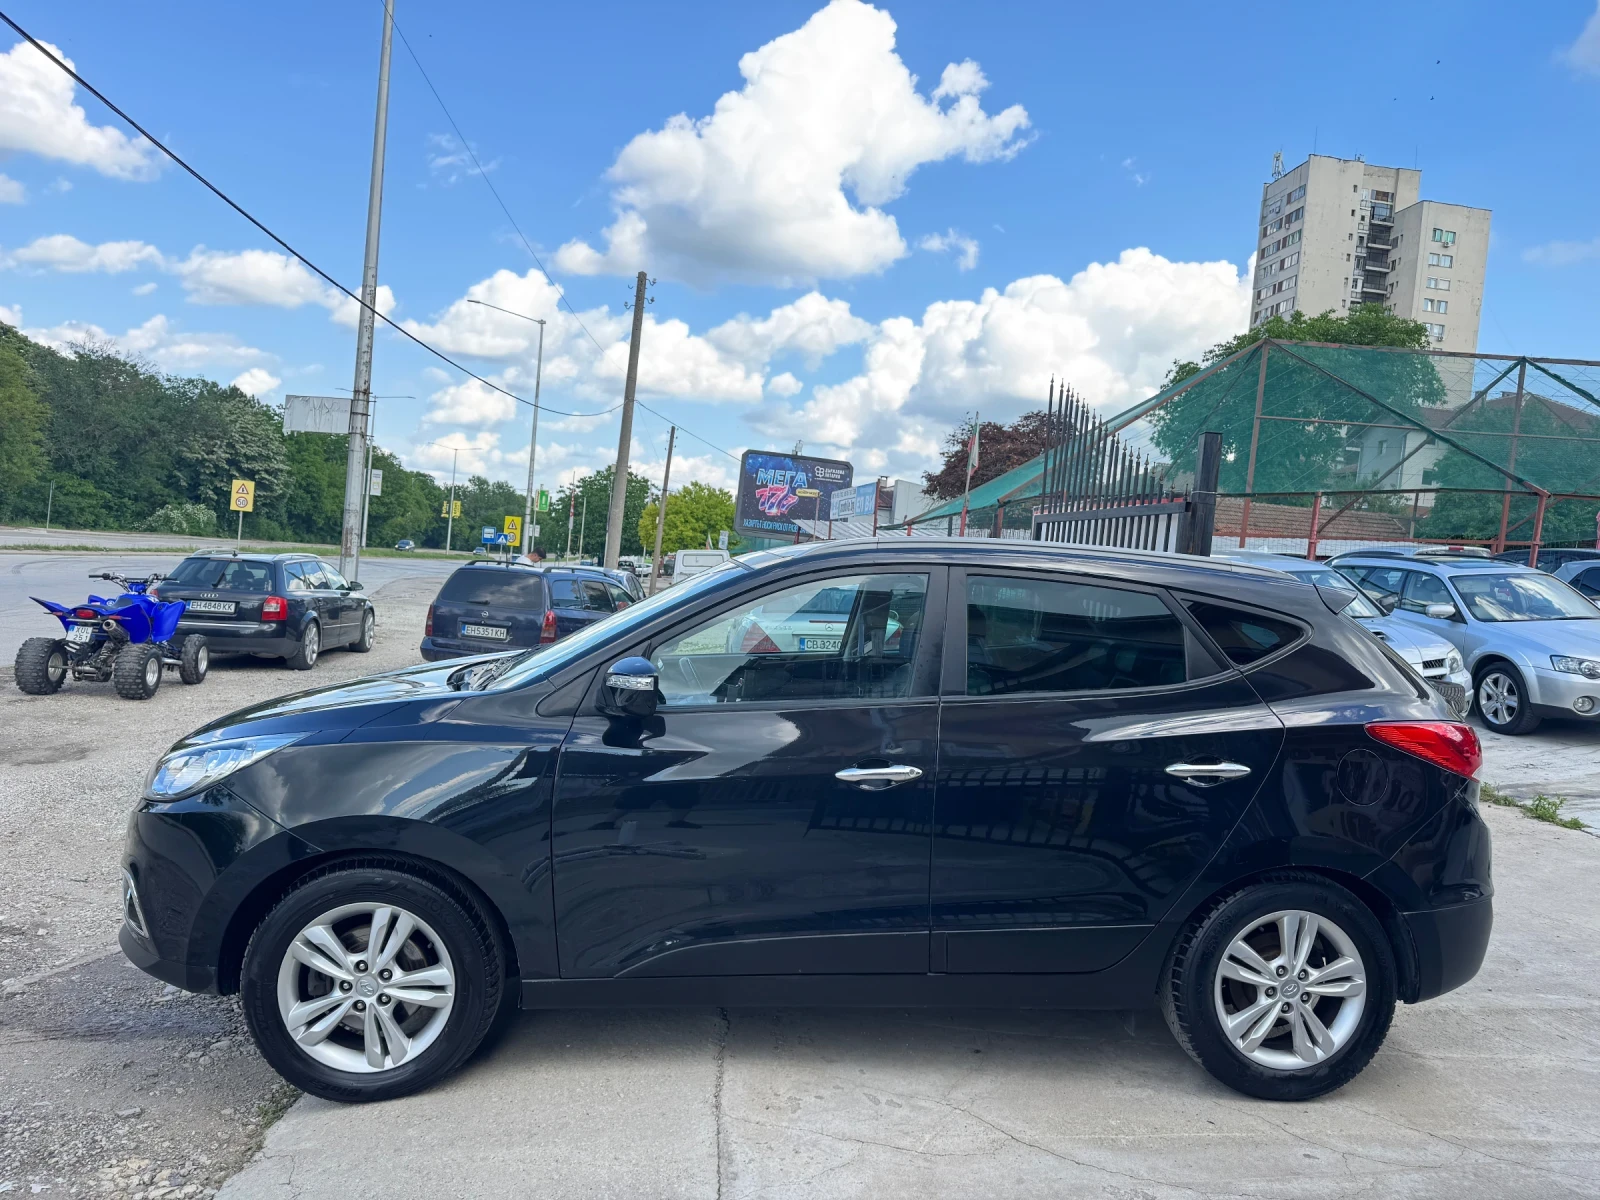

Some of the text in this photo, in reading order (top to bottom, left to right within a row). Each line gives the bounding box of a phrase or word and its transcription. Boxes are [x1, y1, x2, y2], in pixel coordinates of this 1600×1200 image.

[756, 468, 808, 488] МЕГА
[756, 486, 799, 516] 777
[76, 626, 90, 635] XUL
